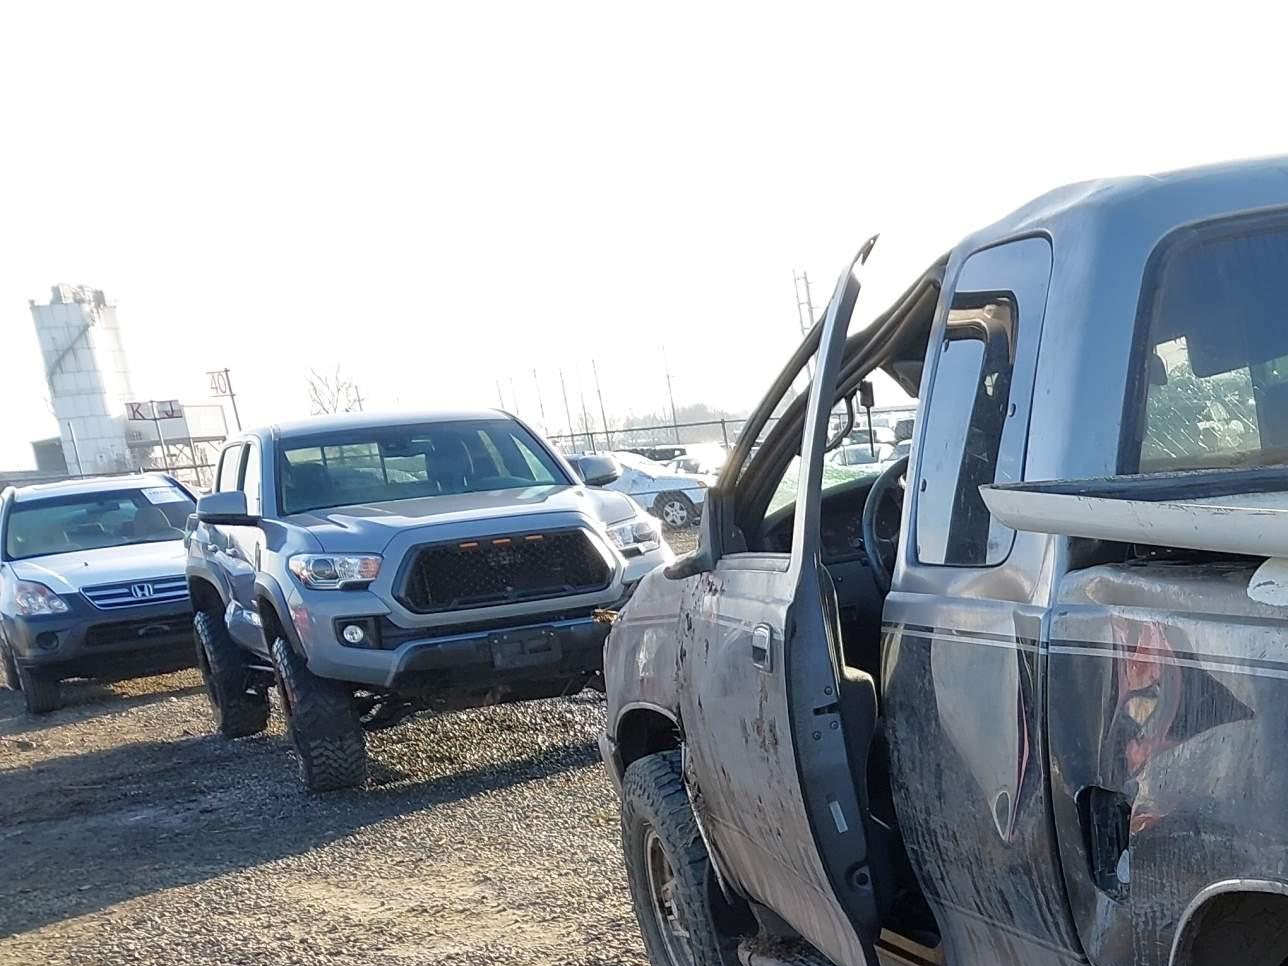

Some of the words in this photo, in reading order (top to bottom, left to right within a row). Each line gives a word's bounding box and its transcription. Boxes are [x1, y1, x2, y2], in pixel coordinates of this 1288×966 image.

[210, 373, 227, 394] 40
[130, 402, 146, 420] K
[164, 400, 175, 418] J
